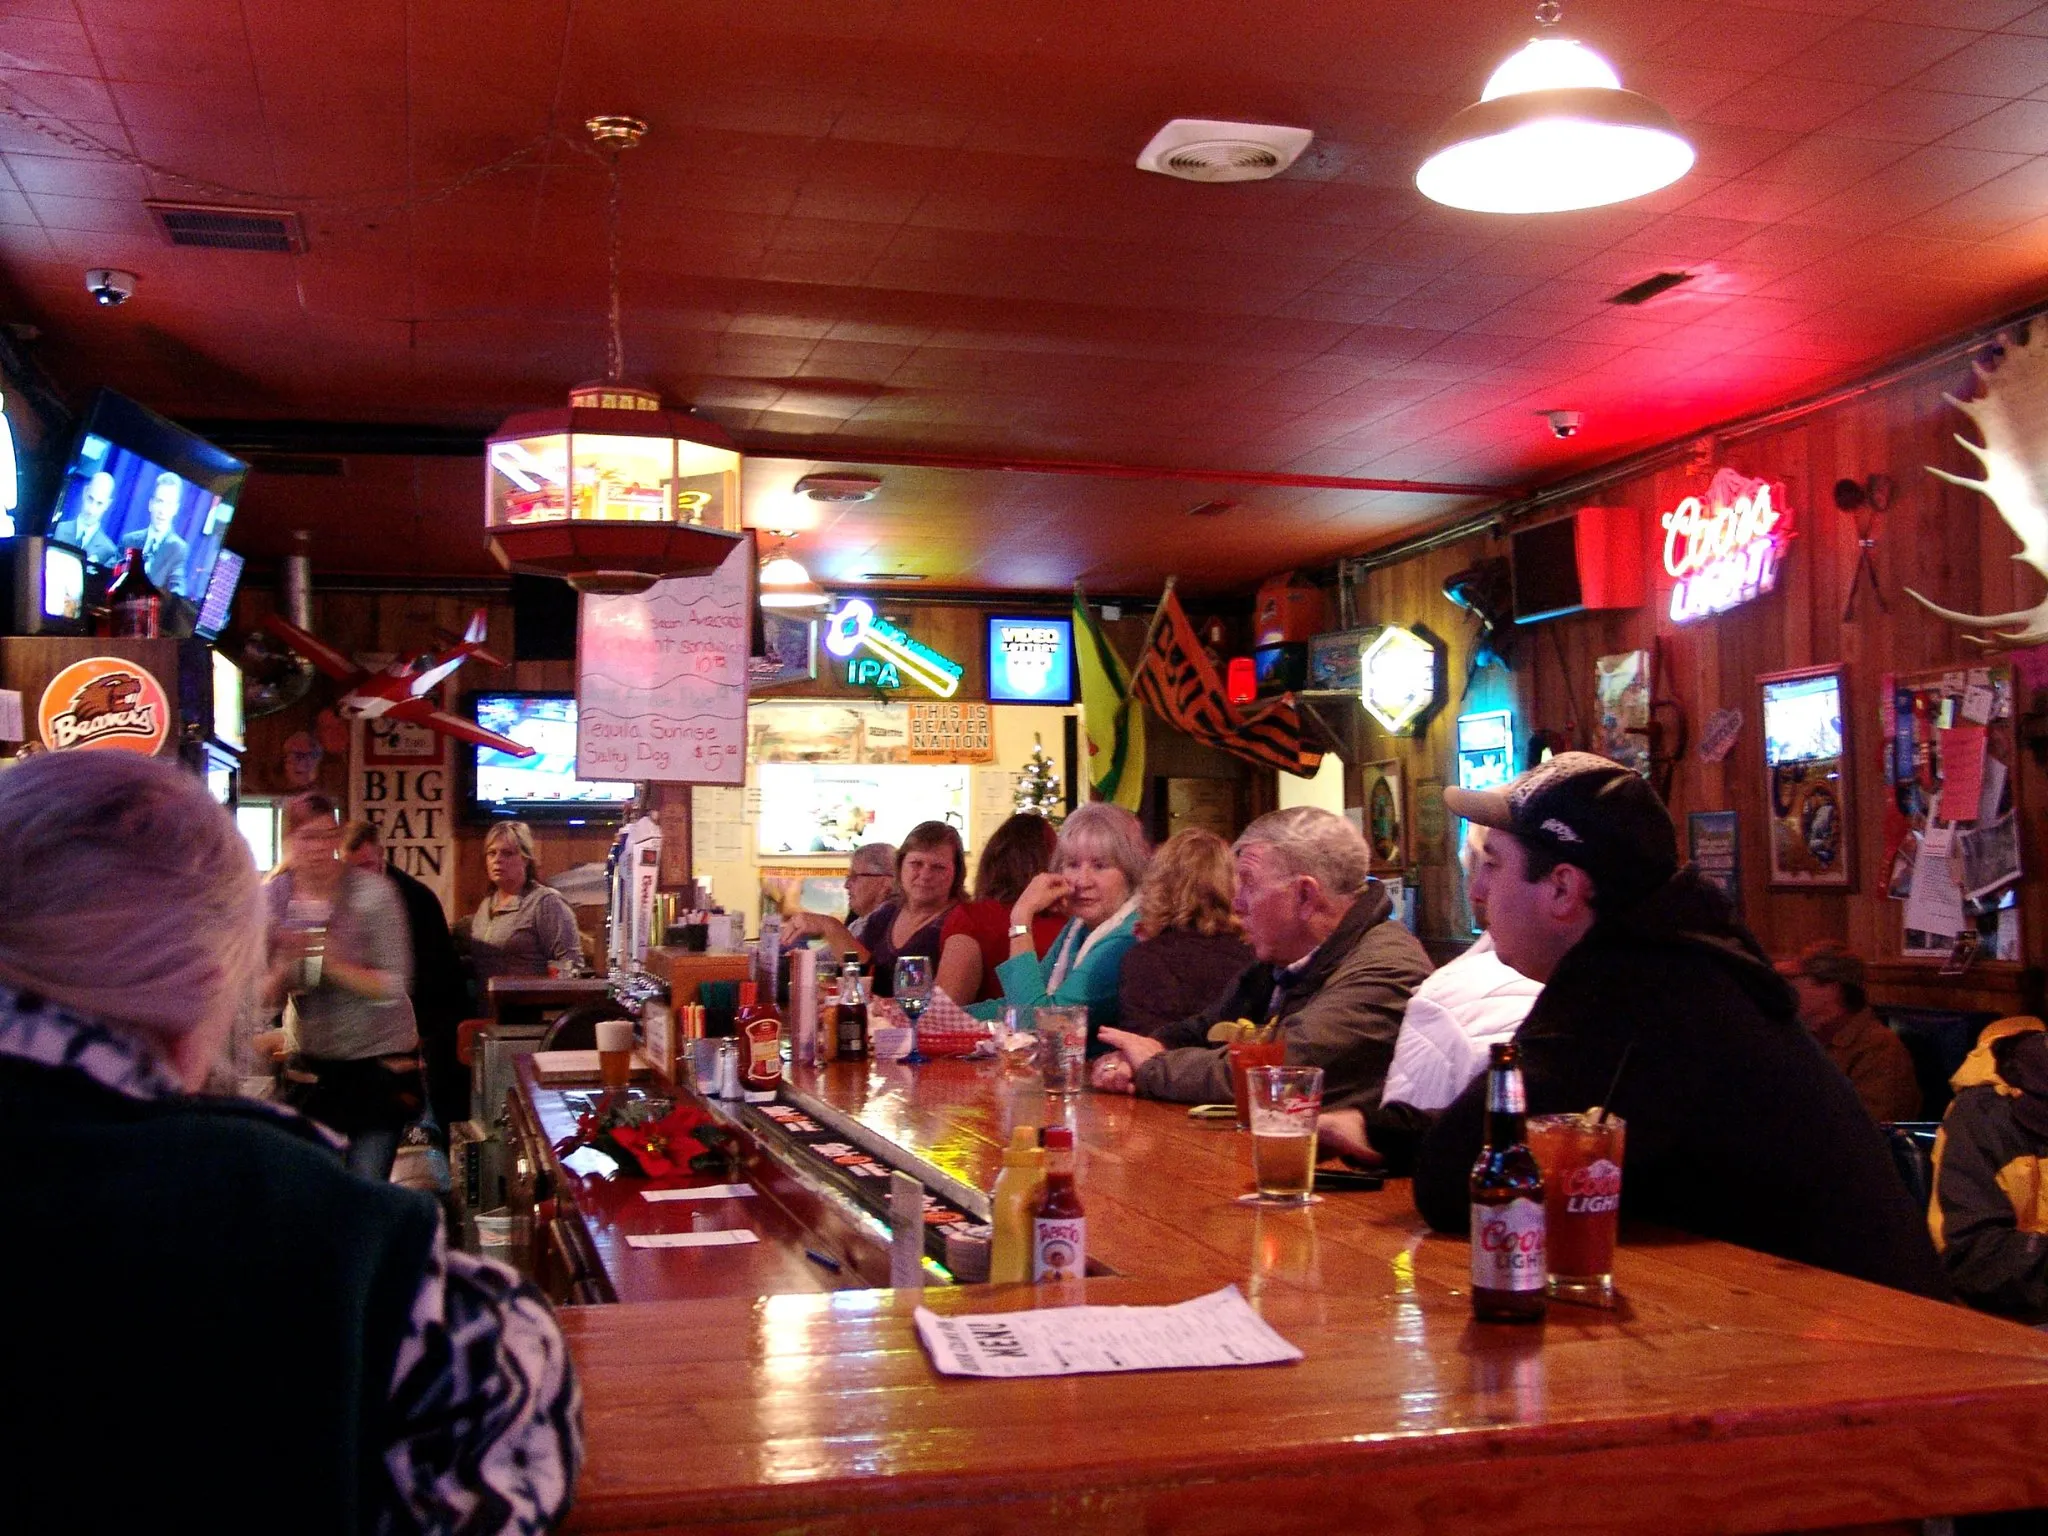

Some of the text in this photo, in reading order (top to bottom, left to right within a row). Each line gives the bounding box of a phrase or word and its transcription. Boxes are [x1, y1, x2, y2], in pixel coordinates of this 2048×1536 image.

[1661, 484, 1781, 577] Coors
[848, 660, 900, 688] IPA
[580, 714, 718, 741] Tequila Sunrise
[912, 720, 989, 734] BEAVER
[915, 705, 987, 719] THIS IS
[584, 742, 630, 773] Salty
[636, 742, 671, 771] Dog
[913, 735, 989, 749] NATION
[363, 769, 444, 803] BIG
[364, 807, 444, 840] FAT
[385, 845, 445, 877] UN
[966, 1323, 1029, 1358] MENU
